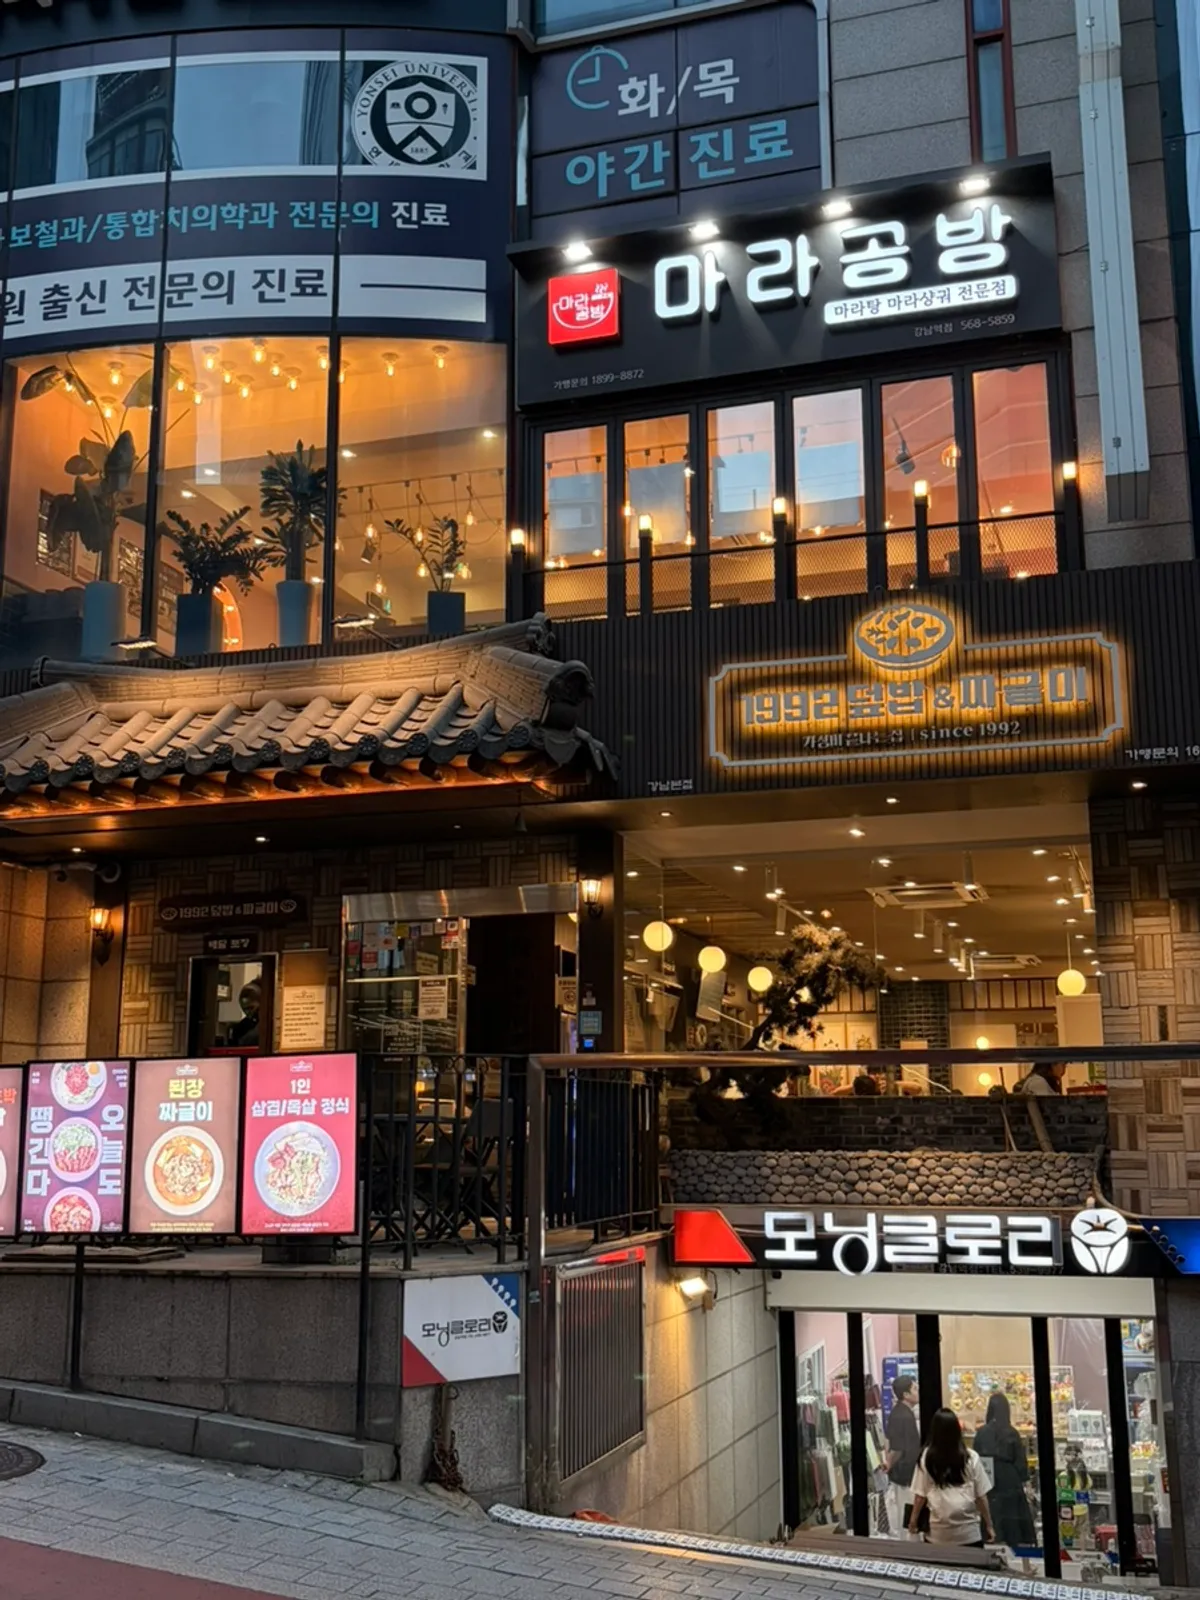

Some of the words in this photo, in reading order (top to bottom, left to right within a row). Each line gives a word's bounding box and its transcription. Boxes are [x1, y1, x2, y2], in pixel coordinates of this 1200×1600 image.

[357, 68, 398, 118] YONSEI
[405, 63, 477, 121] UNIVERSI
[618, 58, 740, 118] 화/목
[566, 140, 671, 198] 야간
[689, 119, 794, 180] 진료
[0, 201, 278, 248] 보철과/통합치의학과
[289, 201, 378, 229] 전문의
[391, 201, 450, 229] 진료
[654, 203, 1013, 320] 마라공방
[39, 279, 108, 321] 출신
[123, 270, 236, 312] 전문의
[252, 268, 327, 304] 진료
[558, 292, 589, 311] 마라
[833, 297, 882, 319] 마라탕
[957, 279, 1007, 301] 전문점
[575, 303, 606, 322] 공방
[914, 323, 953, 338] 강남역점
[960, 313, 1015, 331] 568-5859
[591, 369, 644, 386] 1899-8872
[919, 726, 974, 741] since
[979, 720, 1021, 737] 1992
[1125, 746, 1179, 760] 가맹문의
[169, 1078, 205, 1099] 된장
[290, 1078, 311, 1095] 1인
[159, 1101, 213, 1122] 짜글이
[321, 1096, 350, 1115] 정식
[763, 1210, 1063, 1276] 모닝글로리
[421, 1317, 491, 1347] 모닝글로리
